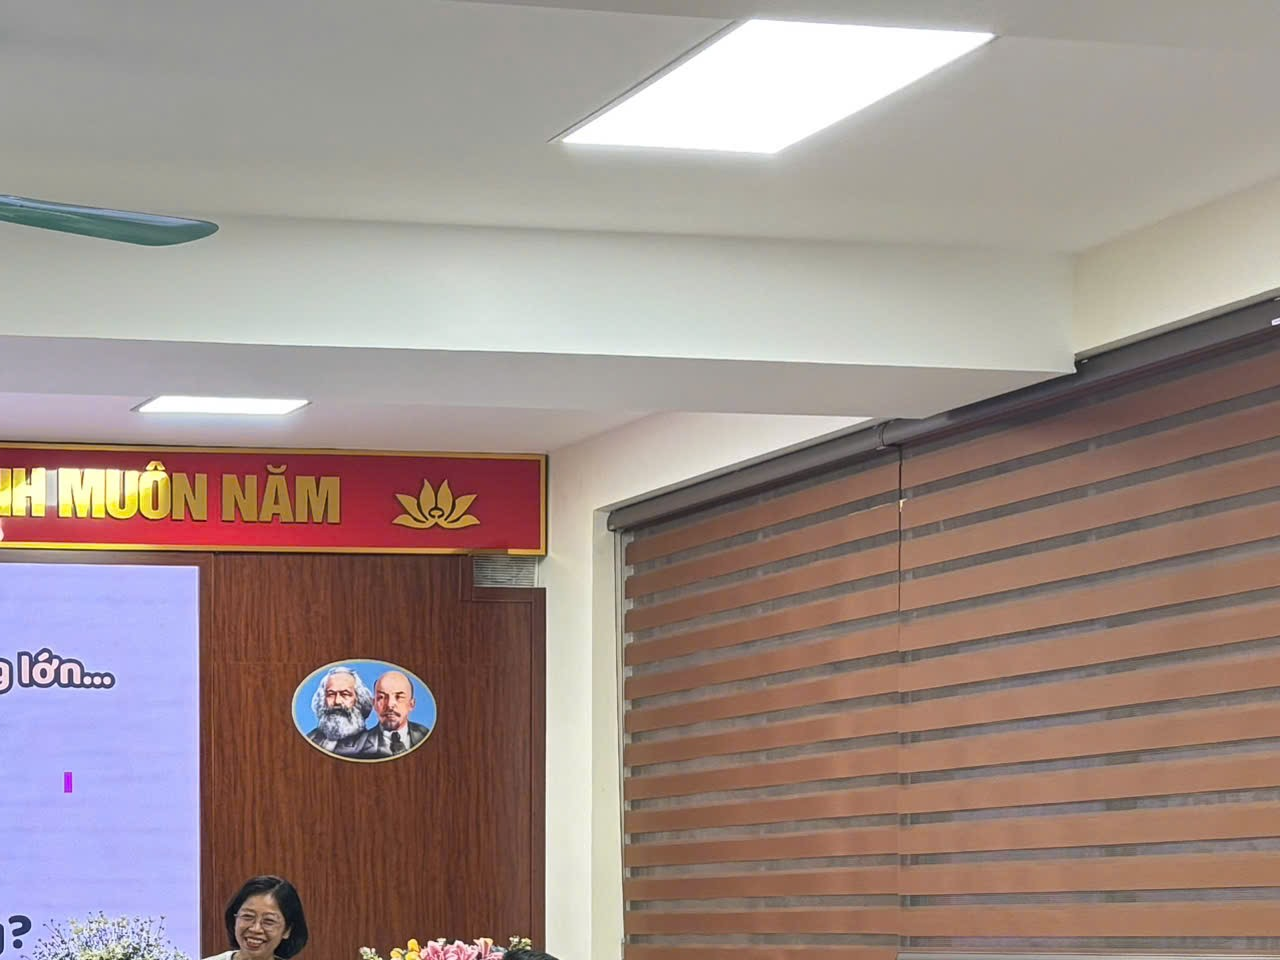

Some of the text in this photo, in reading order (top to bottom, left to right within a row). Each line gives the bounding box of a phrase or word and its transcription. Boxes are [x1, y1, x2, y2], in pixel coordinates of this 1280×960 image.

[58, 460, 209, 522] MUÔN
[221, 463, 342, 525] NĂM
[17, 648, 116, 689] lớn...
